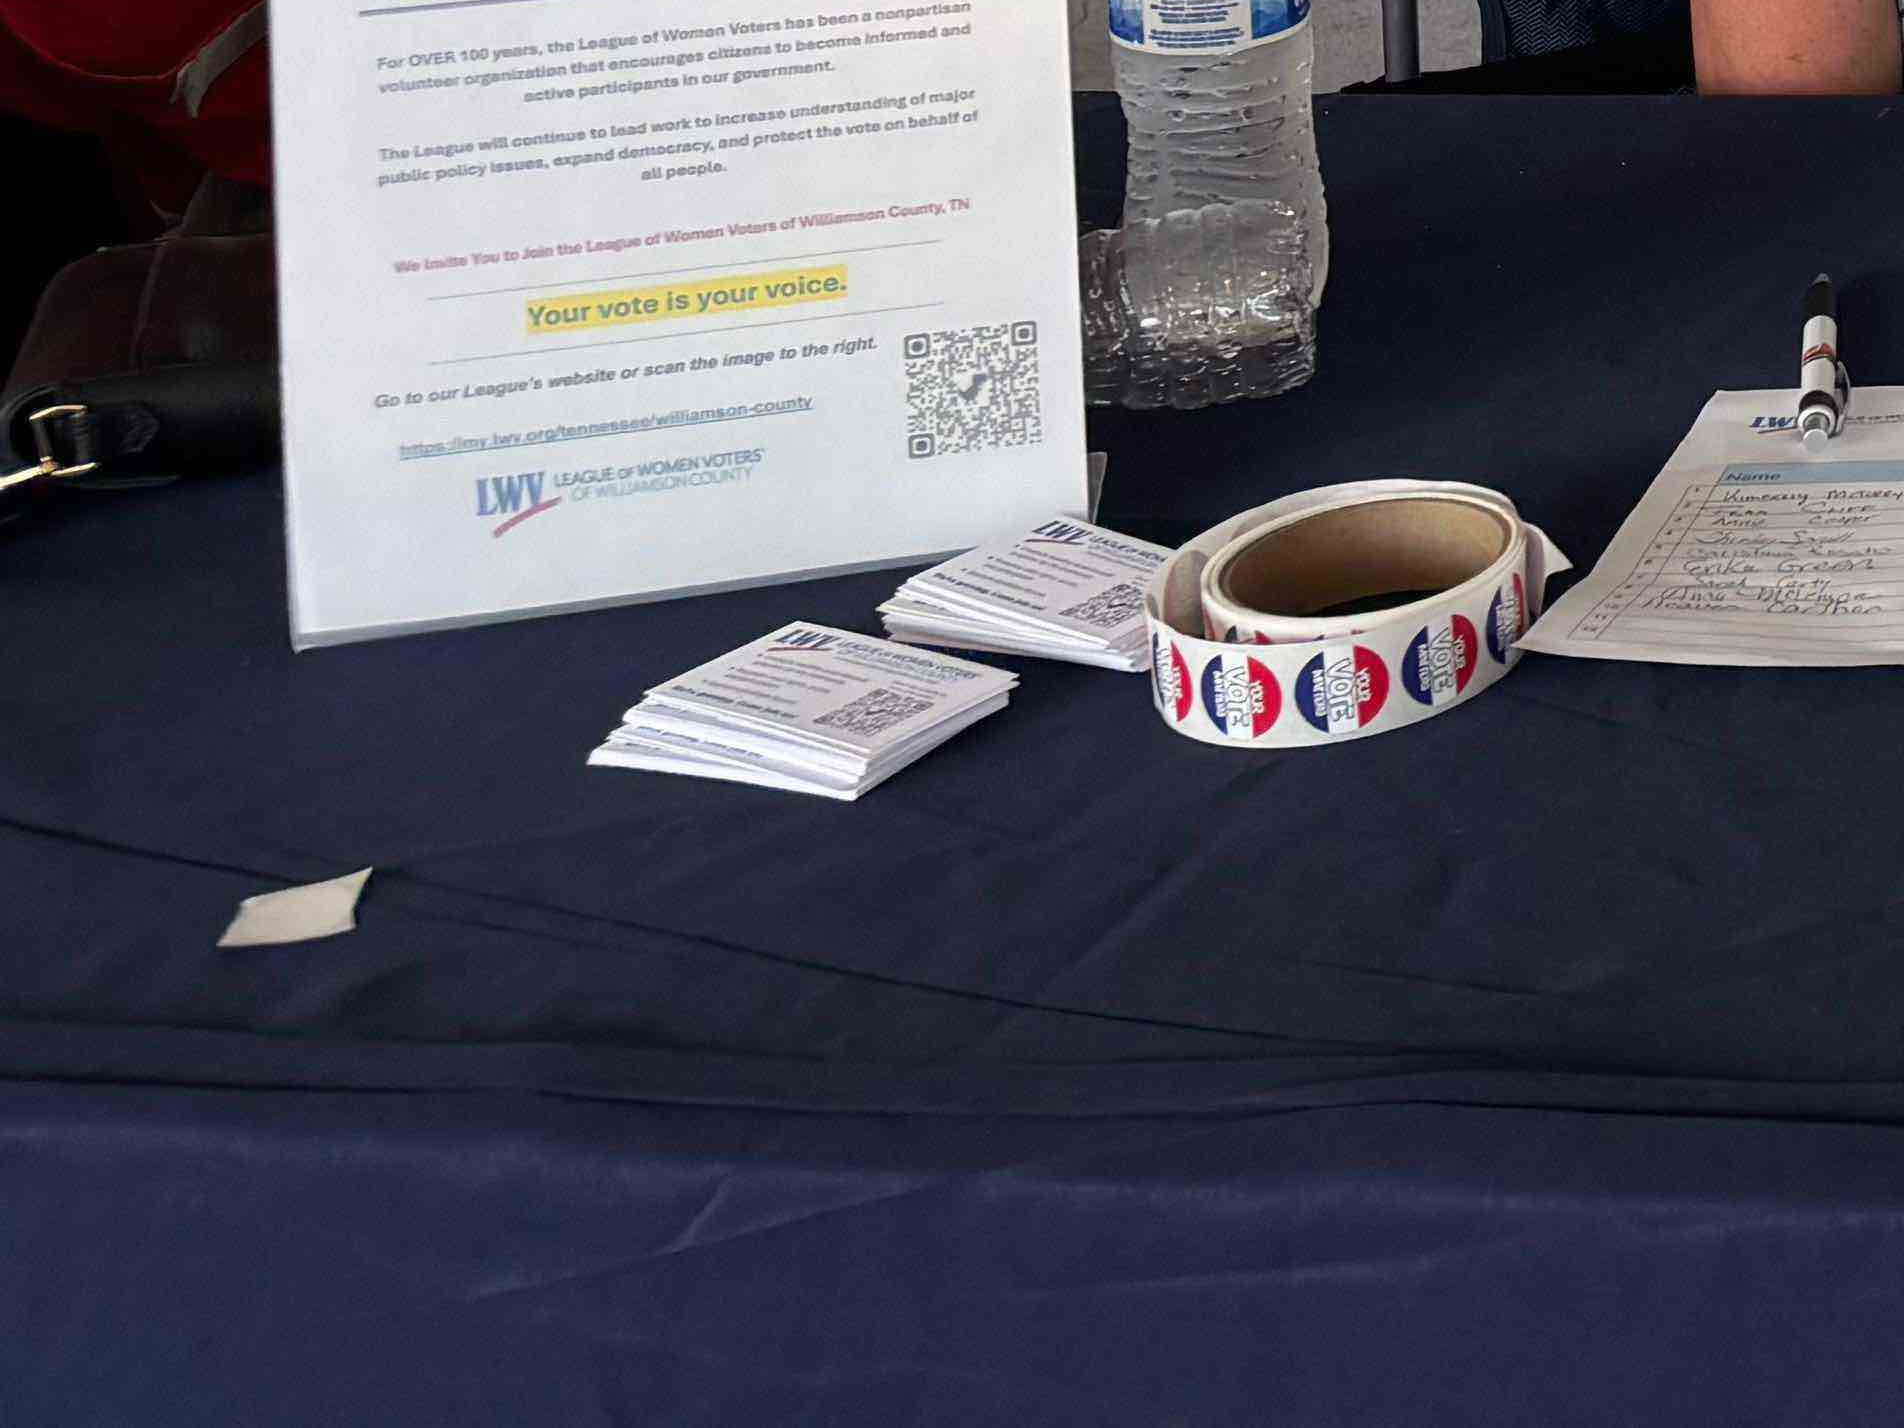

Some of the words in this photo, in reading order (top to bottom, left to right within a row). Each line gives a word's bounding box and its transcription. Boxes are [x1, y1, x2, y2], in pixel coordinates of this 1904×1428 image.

[377, 56, 403, 70] For
[408, 50, 455, 68] OVER
[461, 47, 489, 62] 100
[493, 45, 543, 62] years,
[547, 41, 574, 54] the
[578, 35, 638, 51] League
[642, 31, 659, 45] of
[663, 25, 725, 43] Women
[729, 21, 781, 36] Voters
[785, 17, 814, 31] has
[817, 13, 859, 28] been
[862, 12, 872, 23] a
[875, 2, 971, 21] nonpartisan
[379, 76, 459, 94] volunteer
[465, 65, 567, 87] organization
[570, 61, 604, 75] that
[608, 51, 703, 72] encourages
[708, 44, 771, 61] citizens
[775, 41, 792, 54] to
[795, 36, 861, 53] become
[865, 26, 937, 45] informed
[941, 23, 971, 38] and
[524, 88, 575, 103] active
[578, 77, 679, 100] participants
[683, 74, 699, 86] in
[701, 72, 729, 85] our
[733, 60, 834, 85] government.
[378, 169, 429, 188] public
[435, 164, 485, 181] policy
[490, 158, 550, 175] issues,
[553, 148, 614, 167] expand
[618, 140, 714, 160] democracy,
[718, 132, 749, 150] and
[753, 128, 812, 148] protect
[816, 125, 842, 139] the
[846, 122, 880, 135] vote
[884, 119, 905, 132] on
[908, 111, 960, 129] behalf
[962, 110, 978, 123] of
[380, 147, 410, 160] The
[414, 142, 474, 159] League
[478, 136, 508, 151] will
[512, 130, 586, 148] continue
[590, 127, 607, 140] to
[610, 122, 647, 138] lead
[651, 118, 690, 133] work
[694, 116, 712, 128] to
[715, 109, 786, 126] increase
[790, 96, 907, 120] understanding
[910, 91, 926, 106] of
[929, 89, 975, 104] major
[641, 166, 662, 181] all
[666, 160, 728, 182] people.
[393, 259, 421, 274] We
[425, 256, 467, 271] Invite
[472, 252, 501, 265] You
[504, 250, 519, 262] to
[522, 247, 554, 261] Join
[557, 243, 583, 257] the
[586, 237, 641, 253] League
[645, 233, 660, 247] of
[665, 227, 724, 244] Women
[728, 222, 777, 236] Voters
[780, 216, 796, 231] of
[799, 209, 885, 228] Williamson
[888, 203, 945, 219] County,
[949, 197, 970, 212] TN
[528, 304, 591, 327] Your
[597, 296, 659, 321] vote
[667, 289, 690, 313] is
[697, 285, 758, 314] your
[765, 274, 846, 300] voice.
[375, 393, 400, 409] Go
[405, 391, 423, 405] to
[428, 388, 459, 403] our
[463, 376, 542, 399] League's
[549, 369, 615, 389] website
[620, 367, 639, 380] or
[643, 361, 685, 378] scan
[689, 356, 718, 371] the
[722, 350, 775, 367] image
[779, 348, 797, 361] to
[802, 343, 829, 358] the
[833, 336, 877, 356] right.
[475, 471, 546, 517] LWV
[1326, 657, 1354, 723] VOTE
[1430, 626, 1455, 693] VOTE
[1222, 666, 1251, 728] VOTE
